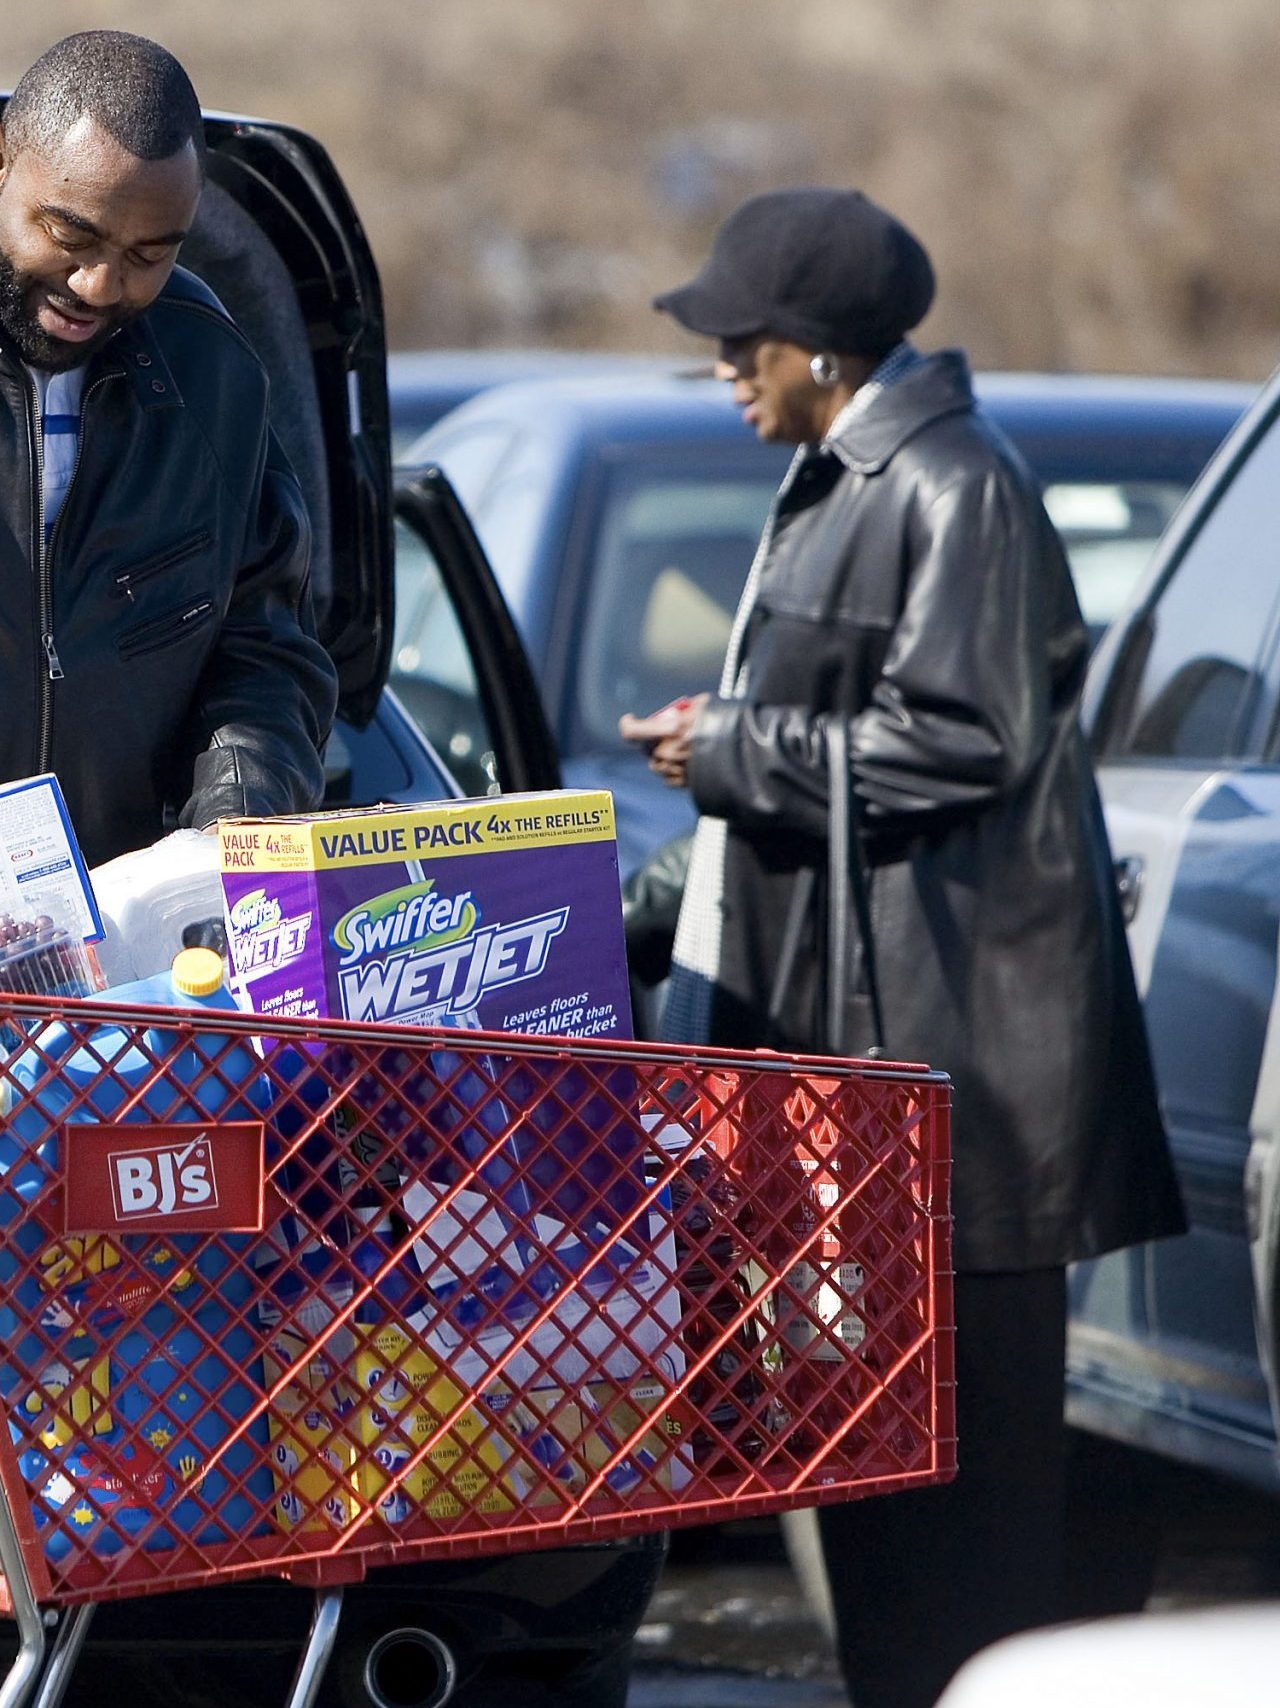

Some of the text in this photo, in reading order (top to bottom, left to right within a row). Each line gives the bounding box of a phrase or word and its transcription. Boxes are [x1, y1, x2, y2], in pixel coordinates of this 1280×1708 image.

[222, 834, 260, 850] VALUE
[265, 834, 292, 854] 4x THE
[320, 828, 407, 859] VALUE
[413, 820, 484, 850] PACK
[486, 814, 512, 834] 4x
[514, 816, 542, 832] THE
[224, 851, 255, 867] PACK
[233, 896, 279, 936] Swiffer
[339, 890, 472, 966] Swiffer
[234, 912, 312, 973] WETJET
[339, 907, 569, 1021] WETJET
[502, 991, 590, 1029] Leaves floors
[566, 1014, 618, 1039] bucket
[586, 1003, 613, 1020] than
